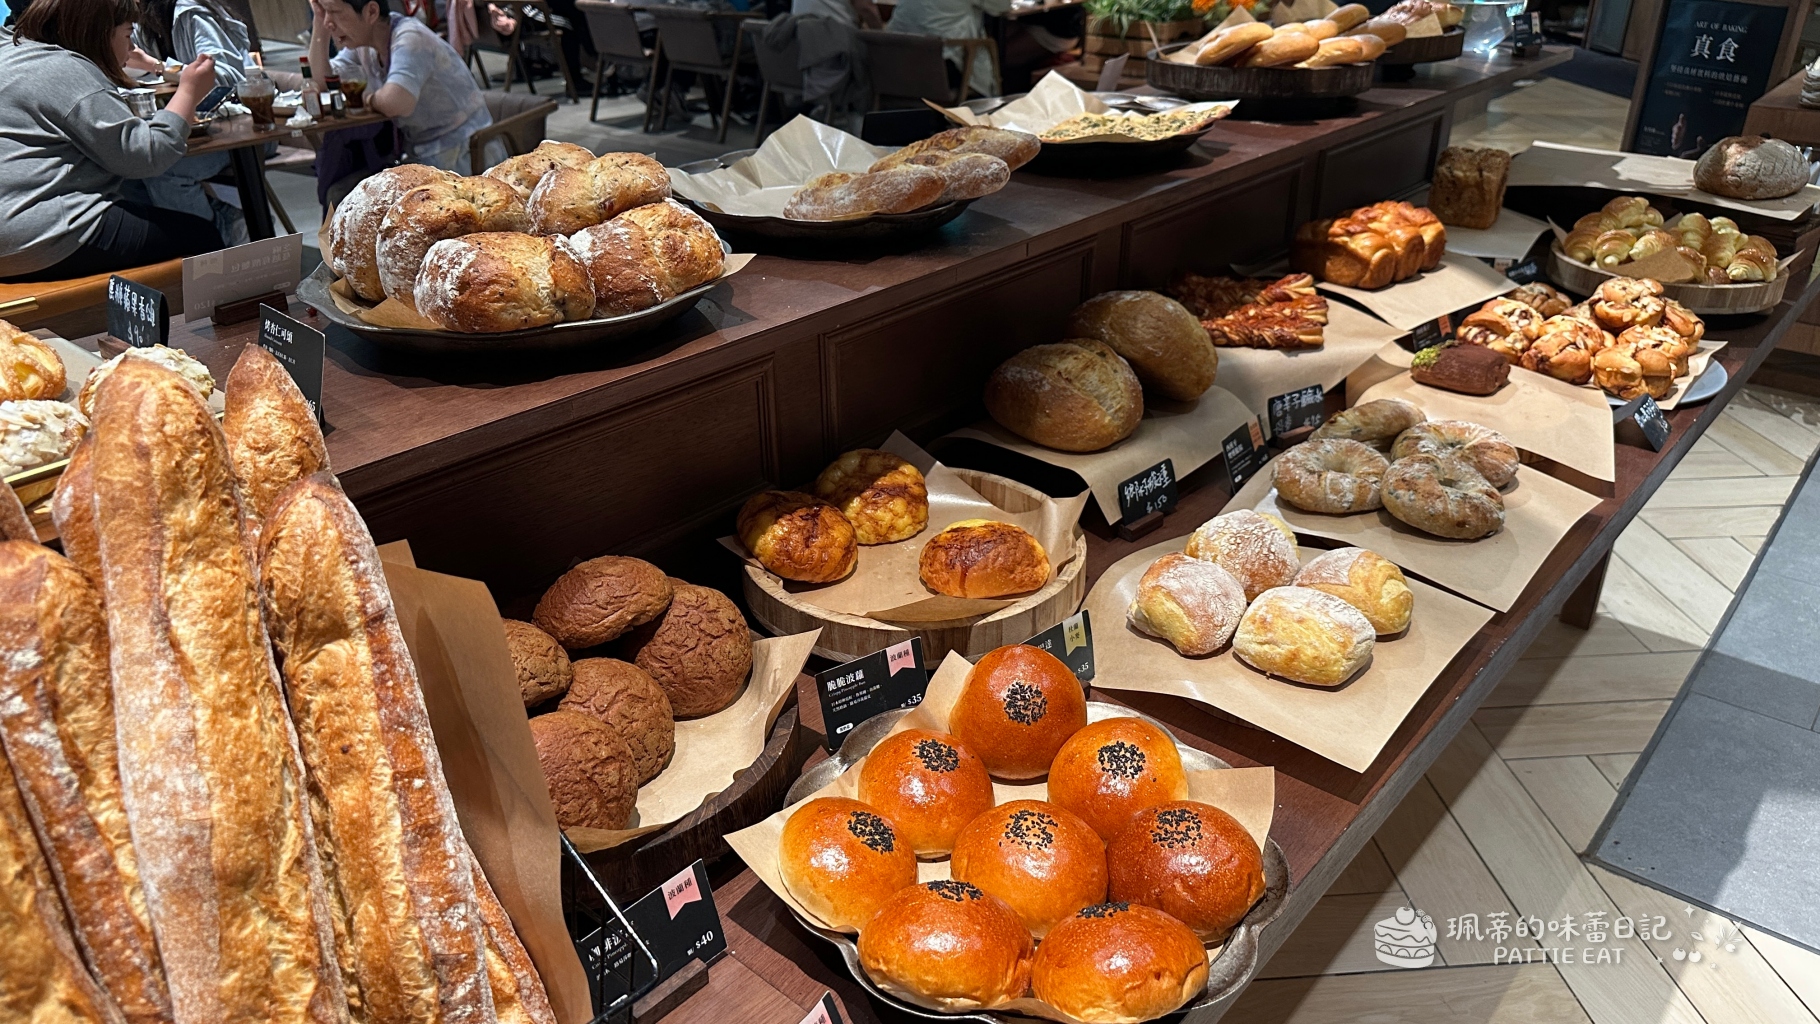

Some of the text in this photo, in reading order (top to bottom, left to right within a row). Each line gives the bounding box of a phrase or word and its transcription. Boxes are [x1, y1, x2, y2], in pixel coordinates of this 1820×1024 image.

[1694, 20, 1708, 29] ART
[1710, 22, 1720, 30] OF
[1690, 33, 1740, 63] 真食
[667, 877, 693, 900] 波蘭種
[695, 930, 714, 949] $40
